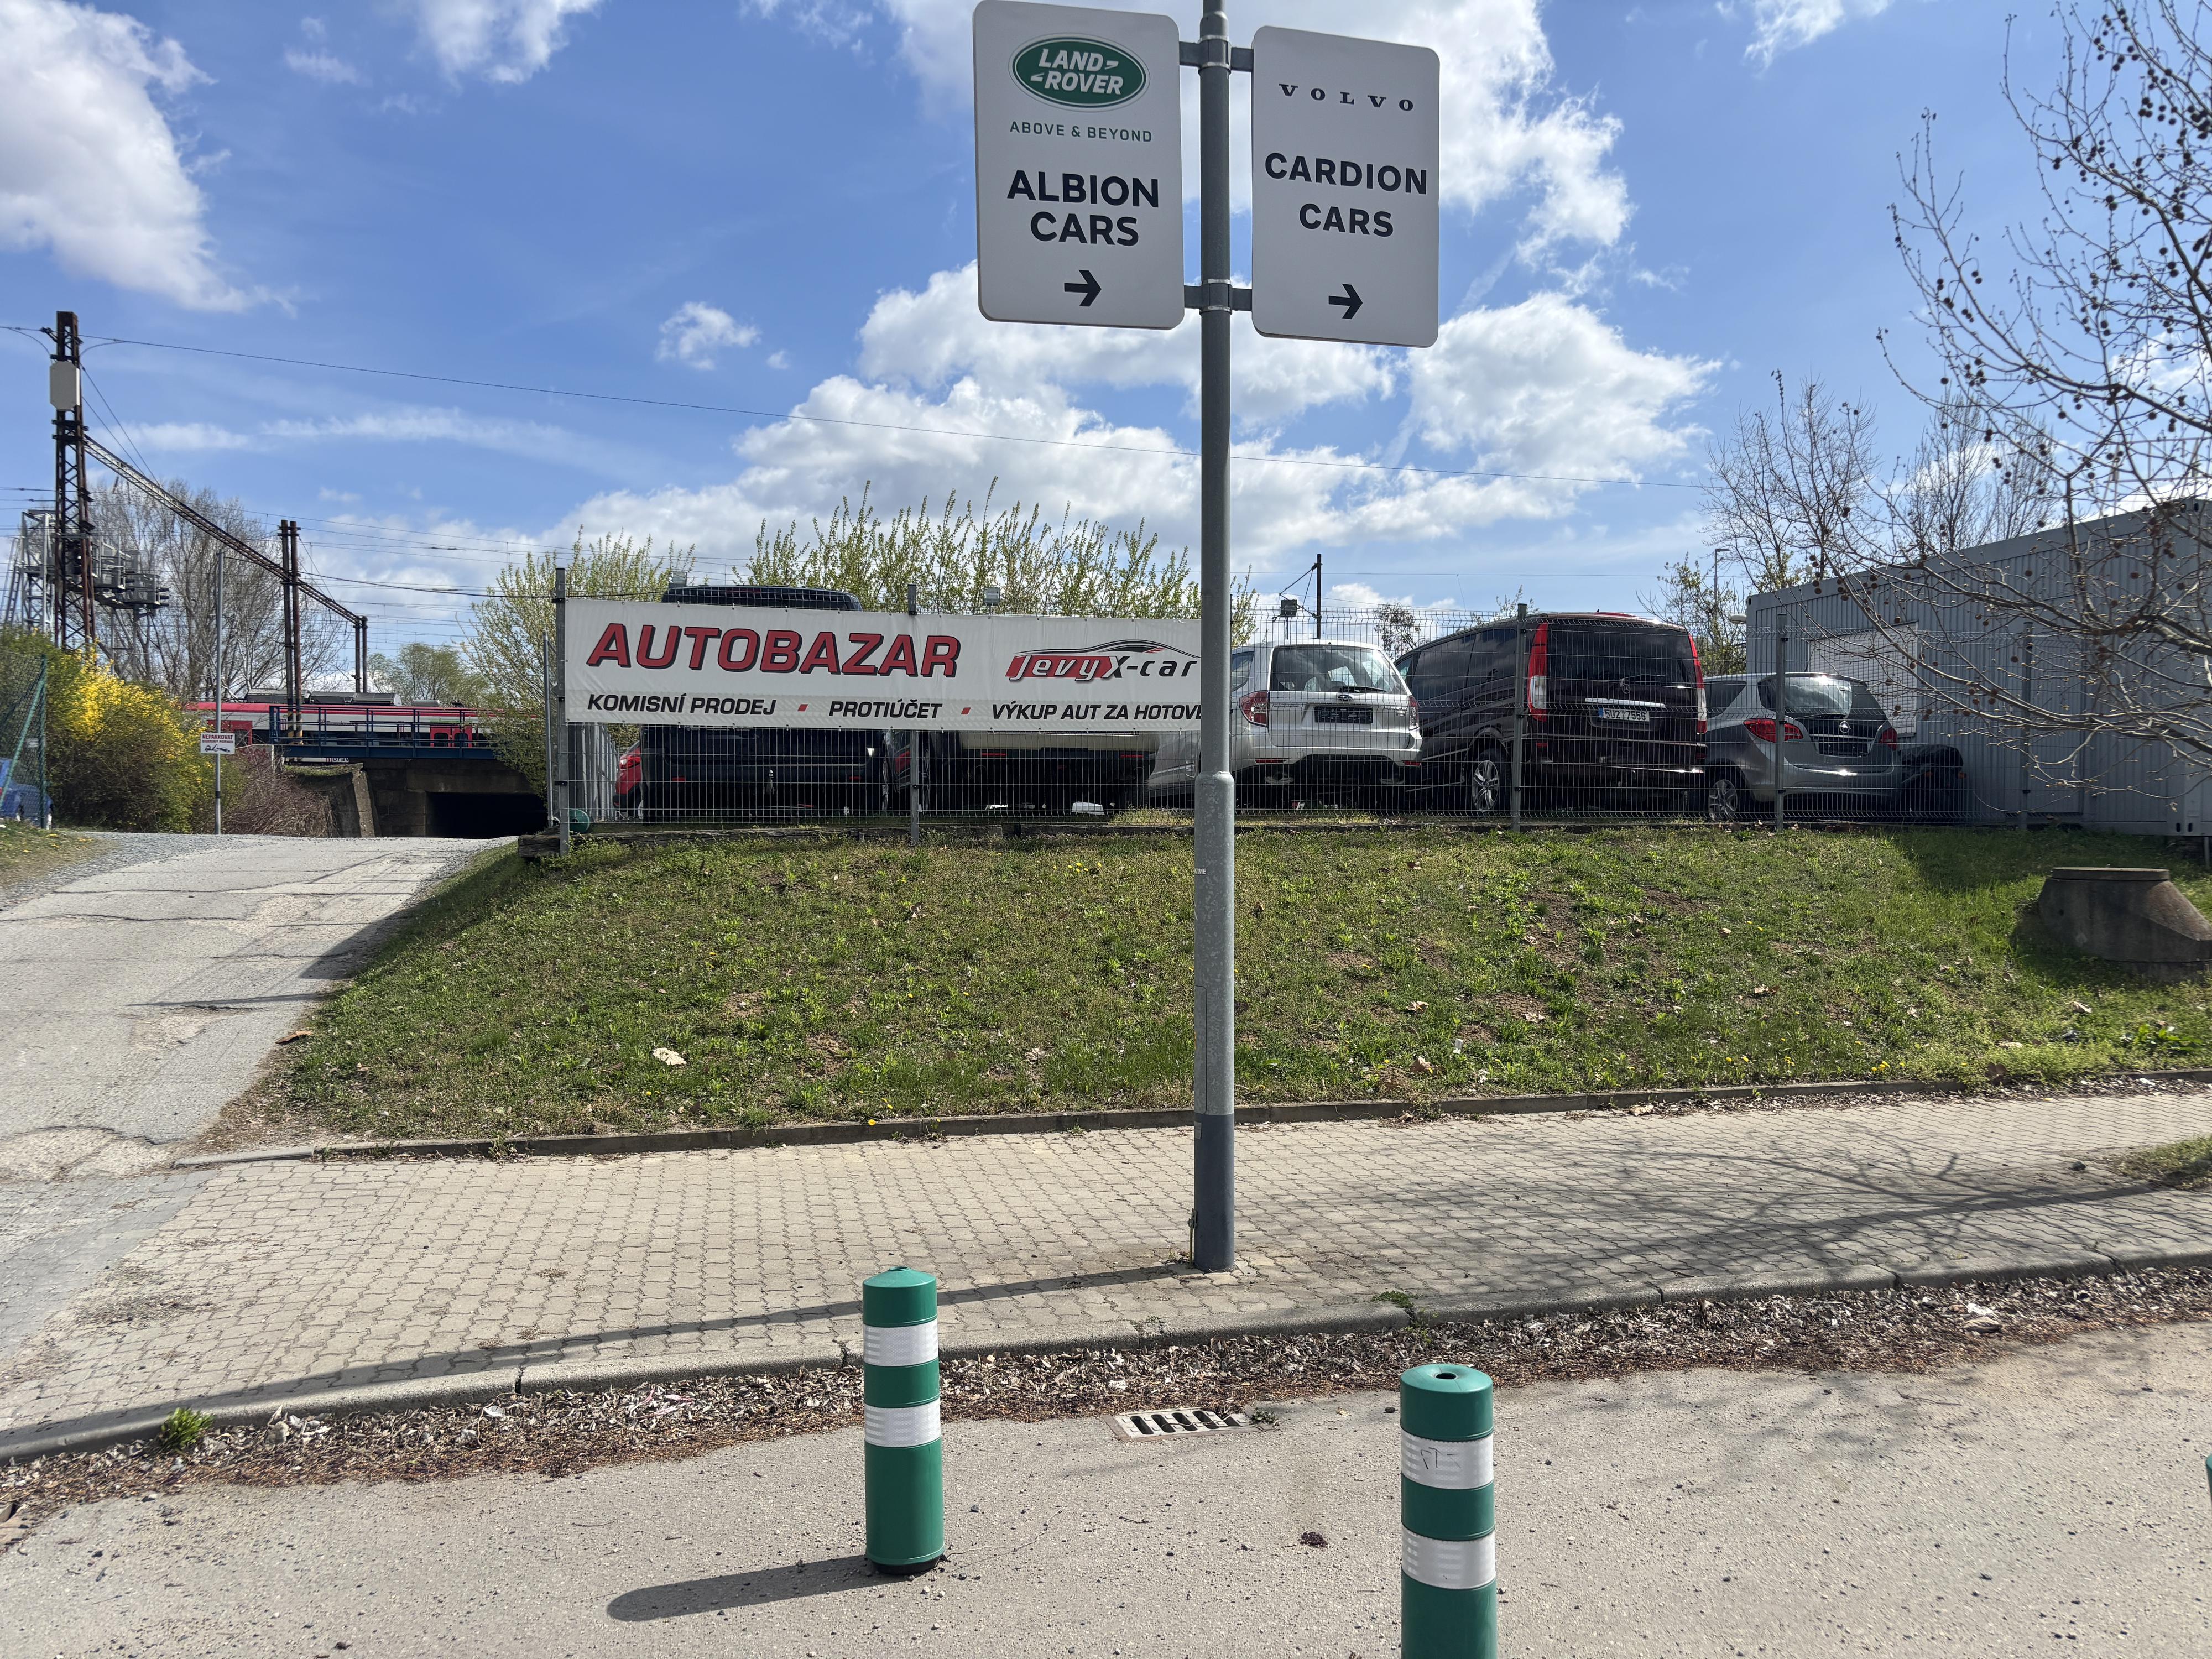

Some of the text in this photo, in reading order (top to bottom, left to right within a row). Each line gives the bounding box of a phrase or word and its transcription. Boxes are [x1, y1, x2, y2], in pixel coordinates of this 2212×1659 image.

[1039, 48, 1104, 71] LAND
[1044, 71, 1124, 95] ROVER
[1279, 83, 1414, 112] VOLVO
[1010, 121, 1152, 142] ABOVE & BEYOND
[1265, 152, 1427, 195] CARDION
[1006, 170, 1159, 208] ALBION
[1030, 211, 1139, 247] CARS
[1299, 203, 1394, 237] CARS
[586, 623, 961, 678] AUTOBAZAR
[587, 693, 776, 716] KOMISNÍ PRODEJ
[828, 698, 943, 719] PROTIÚČET
[992, 700, 1057, 720] VÝKUP
[1060, 705, 1100, 720] AUT
[1103, 705, 1129, 720] ZA
